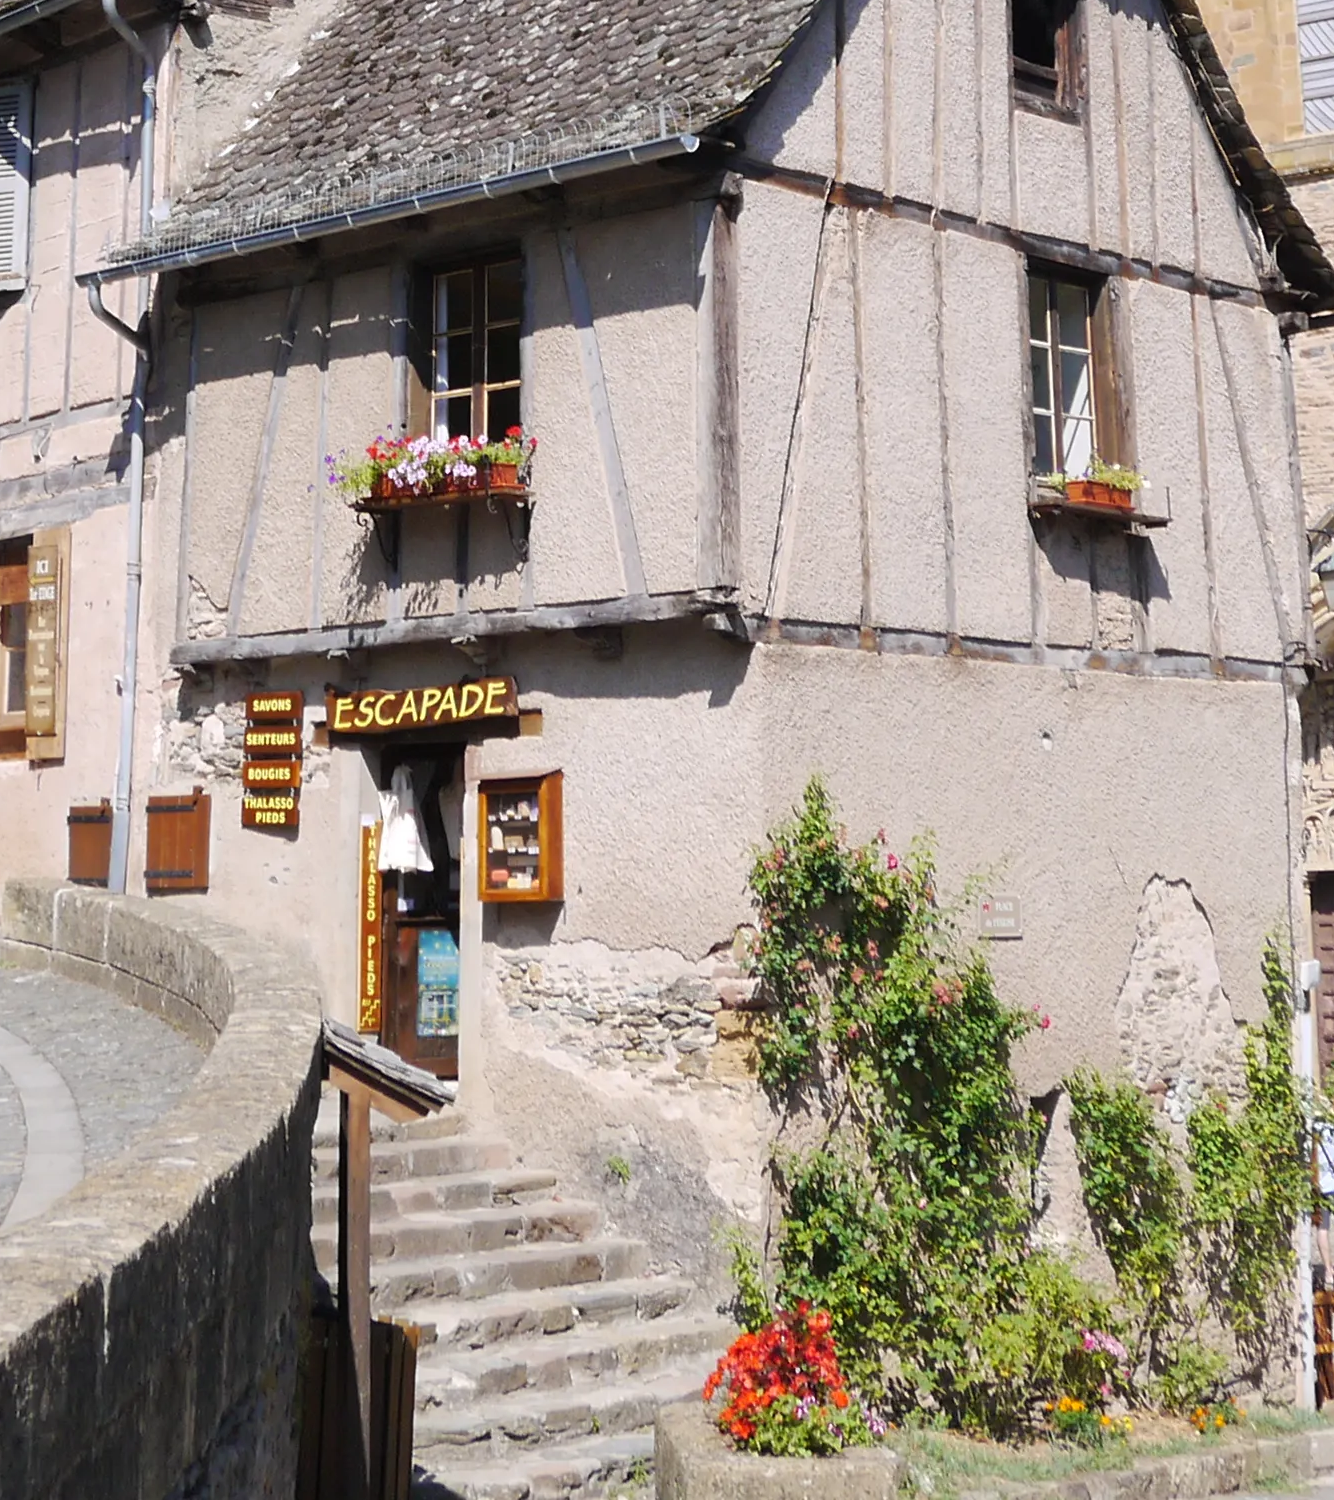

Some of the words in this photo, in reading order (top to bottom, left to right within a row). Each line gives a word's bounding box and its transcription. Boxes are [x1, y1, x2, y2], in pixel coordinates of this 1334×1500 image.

[253, 699, 292, 712] SAVONS
[333, 681, 507, 730] ESCAPADE
[246, 732, 296, 746] SENTEURS
[247, 767, 291, 781] BOUGIES
[244, 796, 294, 811] THALASSO
[255, 811, 286, 824] PIEDS
[367, 825, 377, 922] THALASSO
[367, 935, 375, 996] PIEDS
